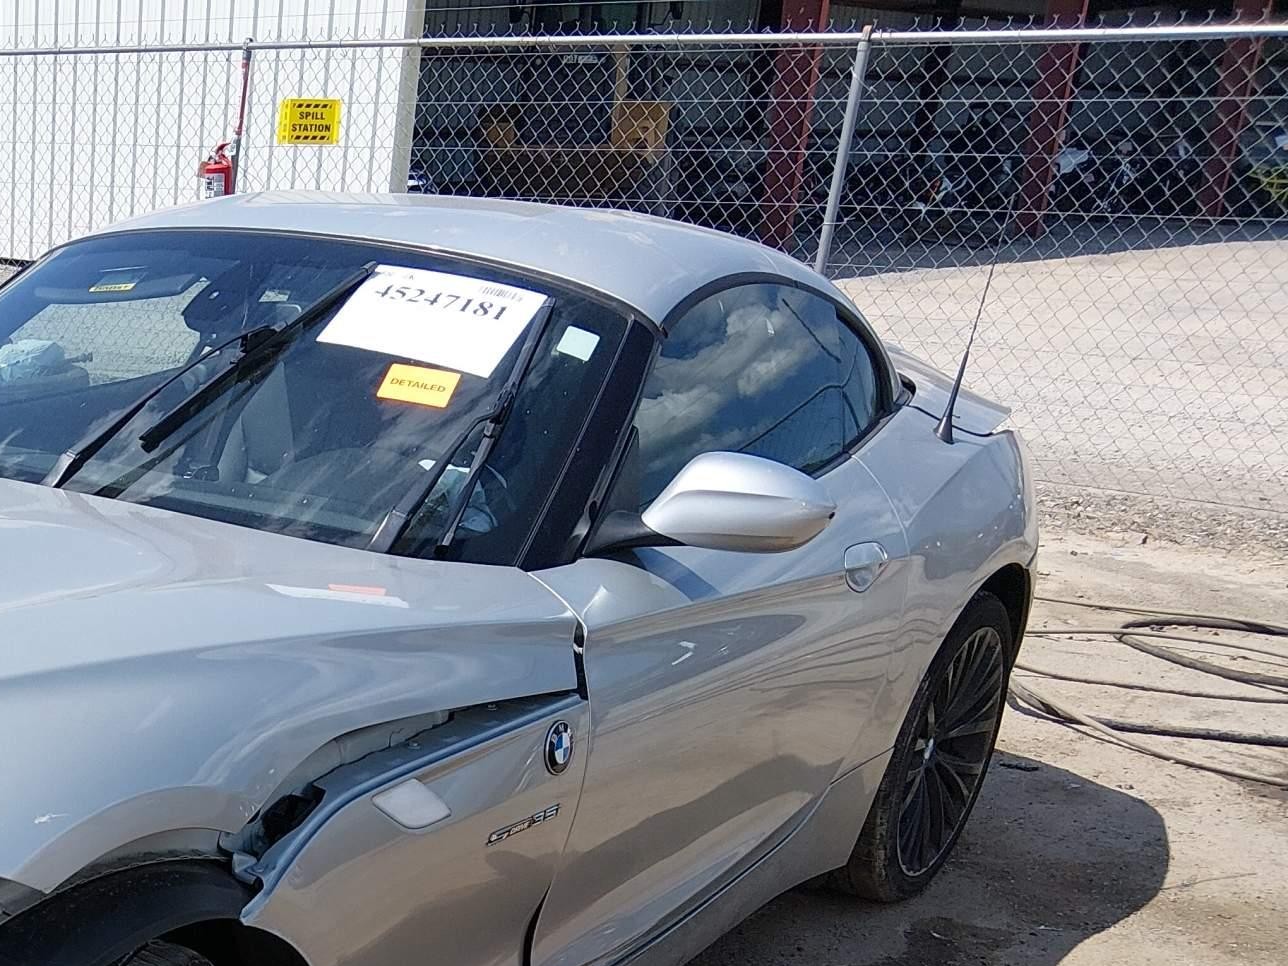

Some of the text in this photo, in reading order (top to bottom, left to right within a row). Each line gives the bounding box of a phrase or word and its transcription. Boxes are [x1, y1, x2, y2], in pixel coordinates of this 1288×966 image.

[298, 111, 326, 120] SPILL
[291, 123, 331, 133] STATION
[375, 284, 507, 320] 45247181
[389, 377, 447, 393] DETAILED
